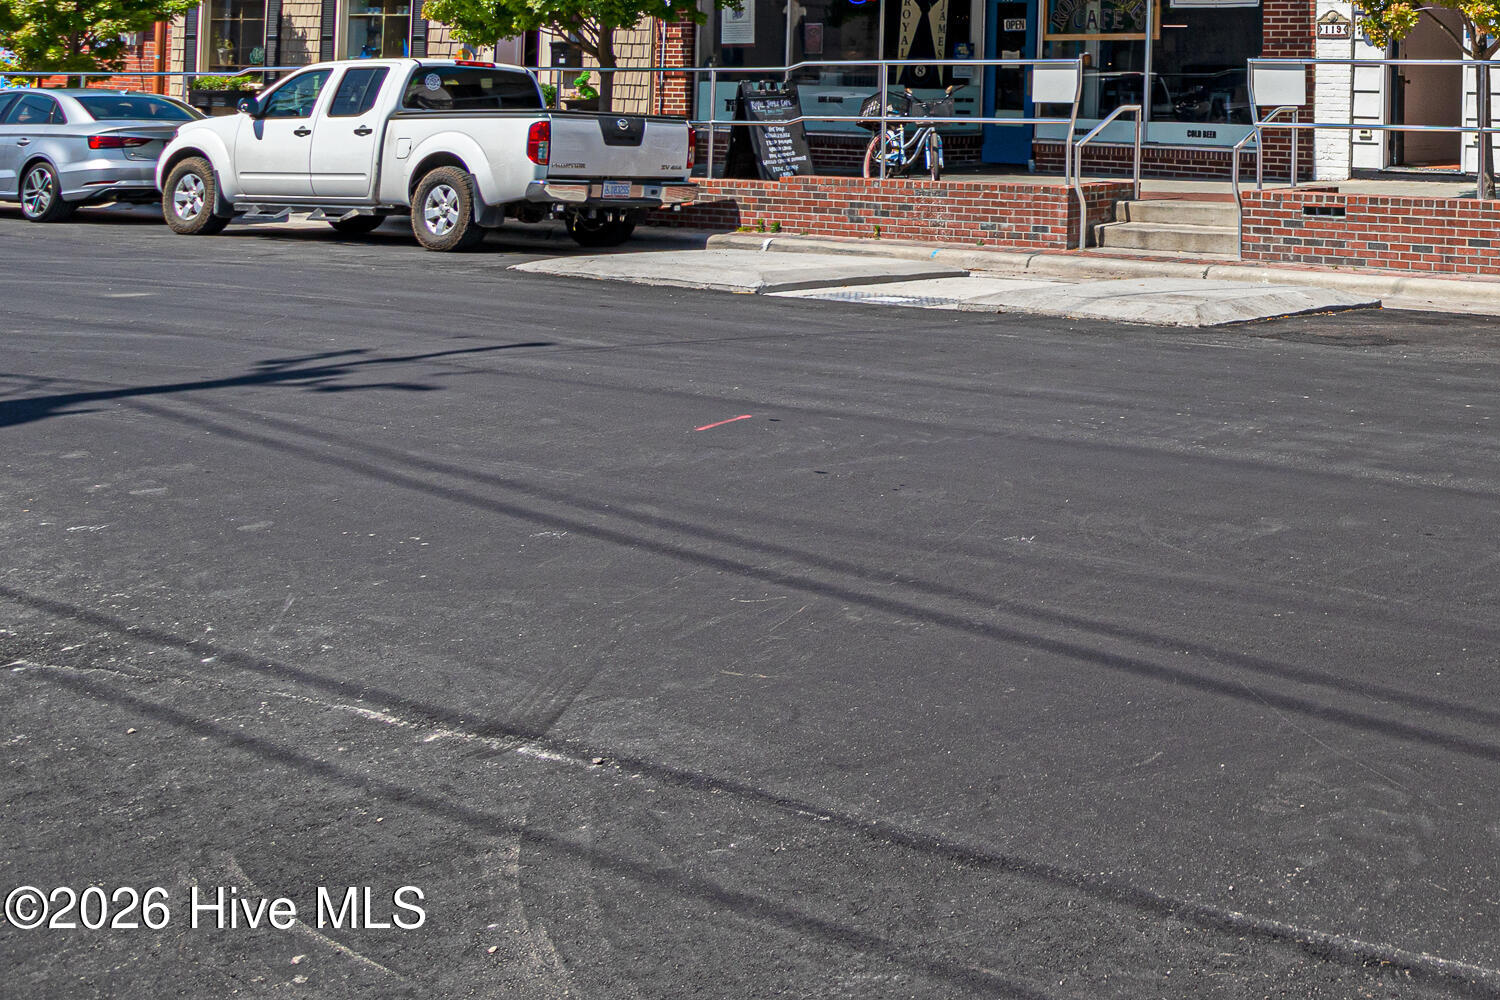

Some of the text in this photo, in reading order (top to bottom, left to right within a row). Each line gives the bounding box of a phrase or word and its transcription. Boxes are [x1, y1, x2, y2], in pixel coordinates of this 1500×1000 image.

[1006, 20, 1025, 30] OPEN
[1073, 9, 1124, 31] CAFE
[937, 0, 946, 60] JAMES
[1325, 25, 1342, 34] 119
[1187, 130, 1216, 139] COLD BEER
